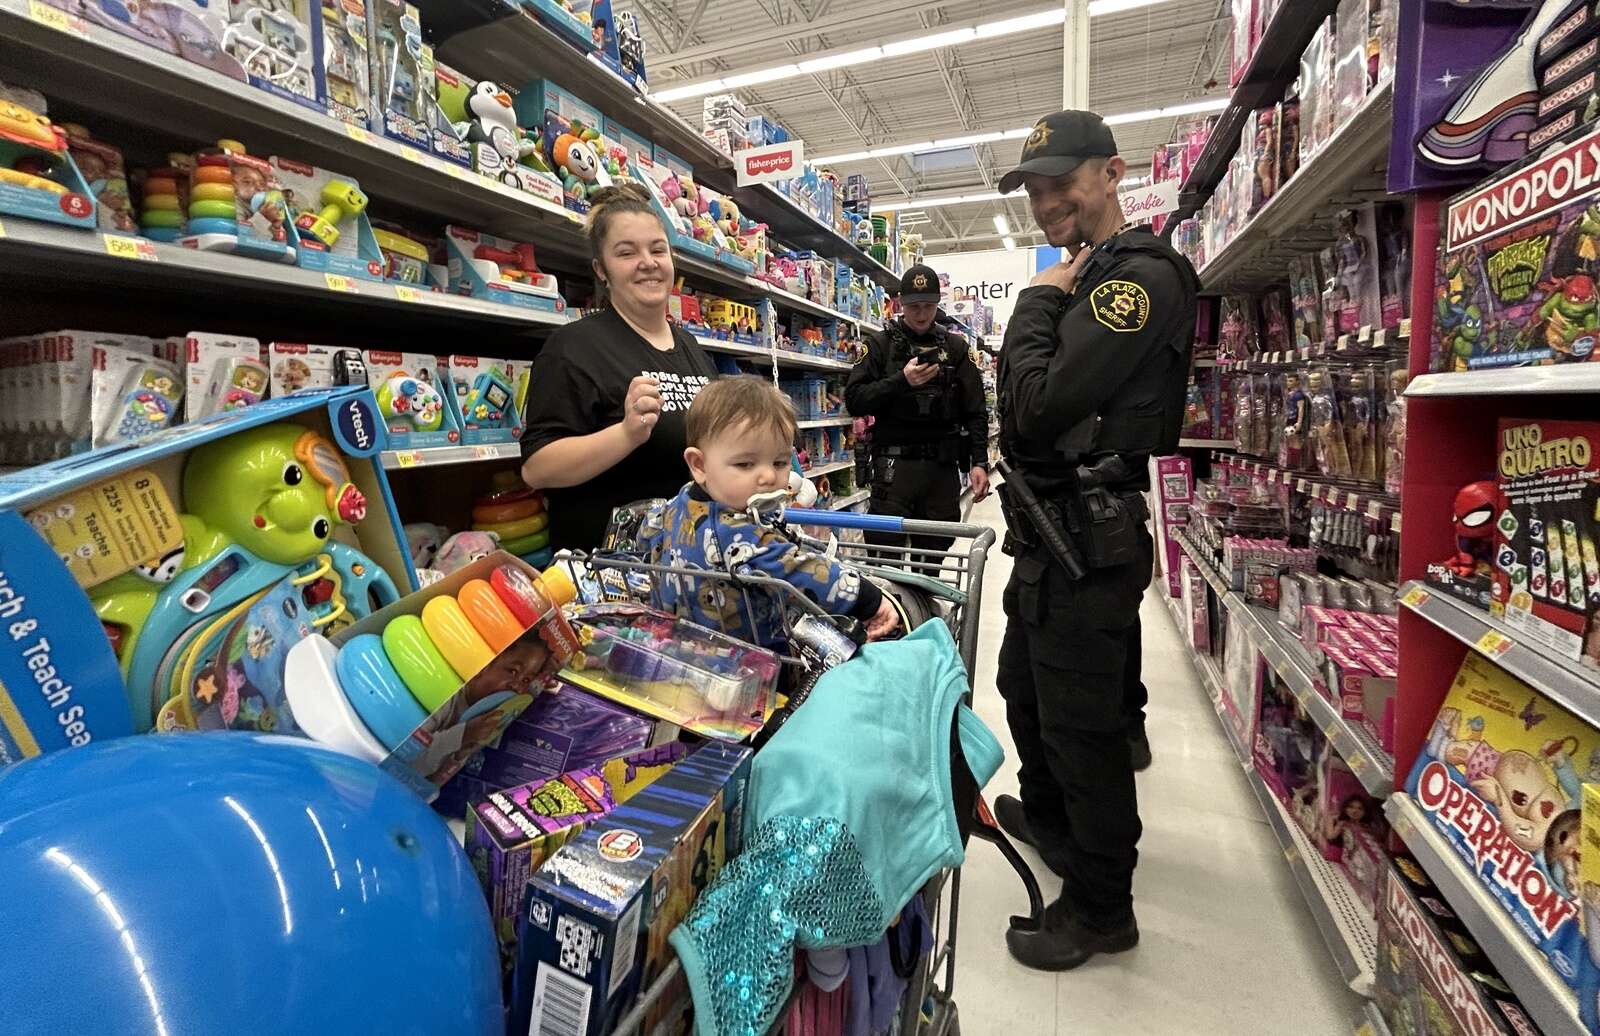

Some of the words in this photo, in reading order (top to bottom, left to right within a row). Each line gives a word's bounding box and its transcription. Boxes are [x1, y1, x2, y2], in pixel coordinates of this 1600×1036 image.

[1541, 11, 1585, 49] MONOPOLY
[1546, 43, 1595, 78] MONOPOLY
[1541, 75, 1592, 110] MONOPOLY
[1530, 113, 1573, 145] MONOPOLY
[1123, 193, 1165, 217] Barbie
[1097, 286, 1111, 298] LA
[1111, 283, 1137, 295] PLATA
[1136, 293, 1147, 326] COUNTY
[1098, 306, 1128, 327] SHERIFF
[349, 400, 369, 448] vtech
[1503, 424, 1542, 452] UNO
[1499, 436, 1592, 479] QUATRO
[135, 478, 150, 490] 8
[1543, 474, 1561, 483] Four
[1561, 473, 1570, 481] in
[102, 485, 124, 515] 225+
[84, 511, 111, 558] Teaches
[1427, 563, 1446, 576] bop
[9, 618, 38, 642] &
[21, 636, 73, 709] Teach
[57, 704, 91, 748] Sea
[1418, 760, 1577, 938] OPERATION
[1390, 876, 1497, 1036] MONOPO
